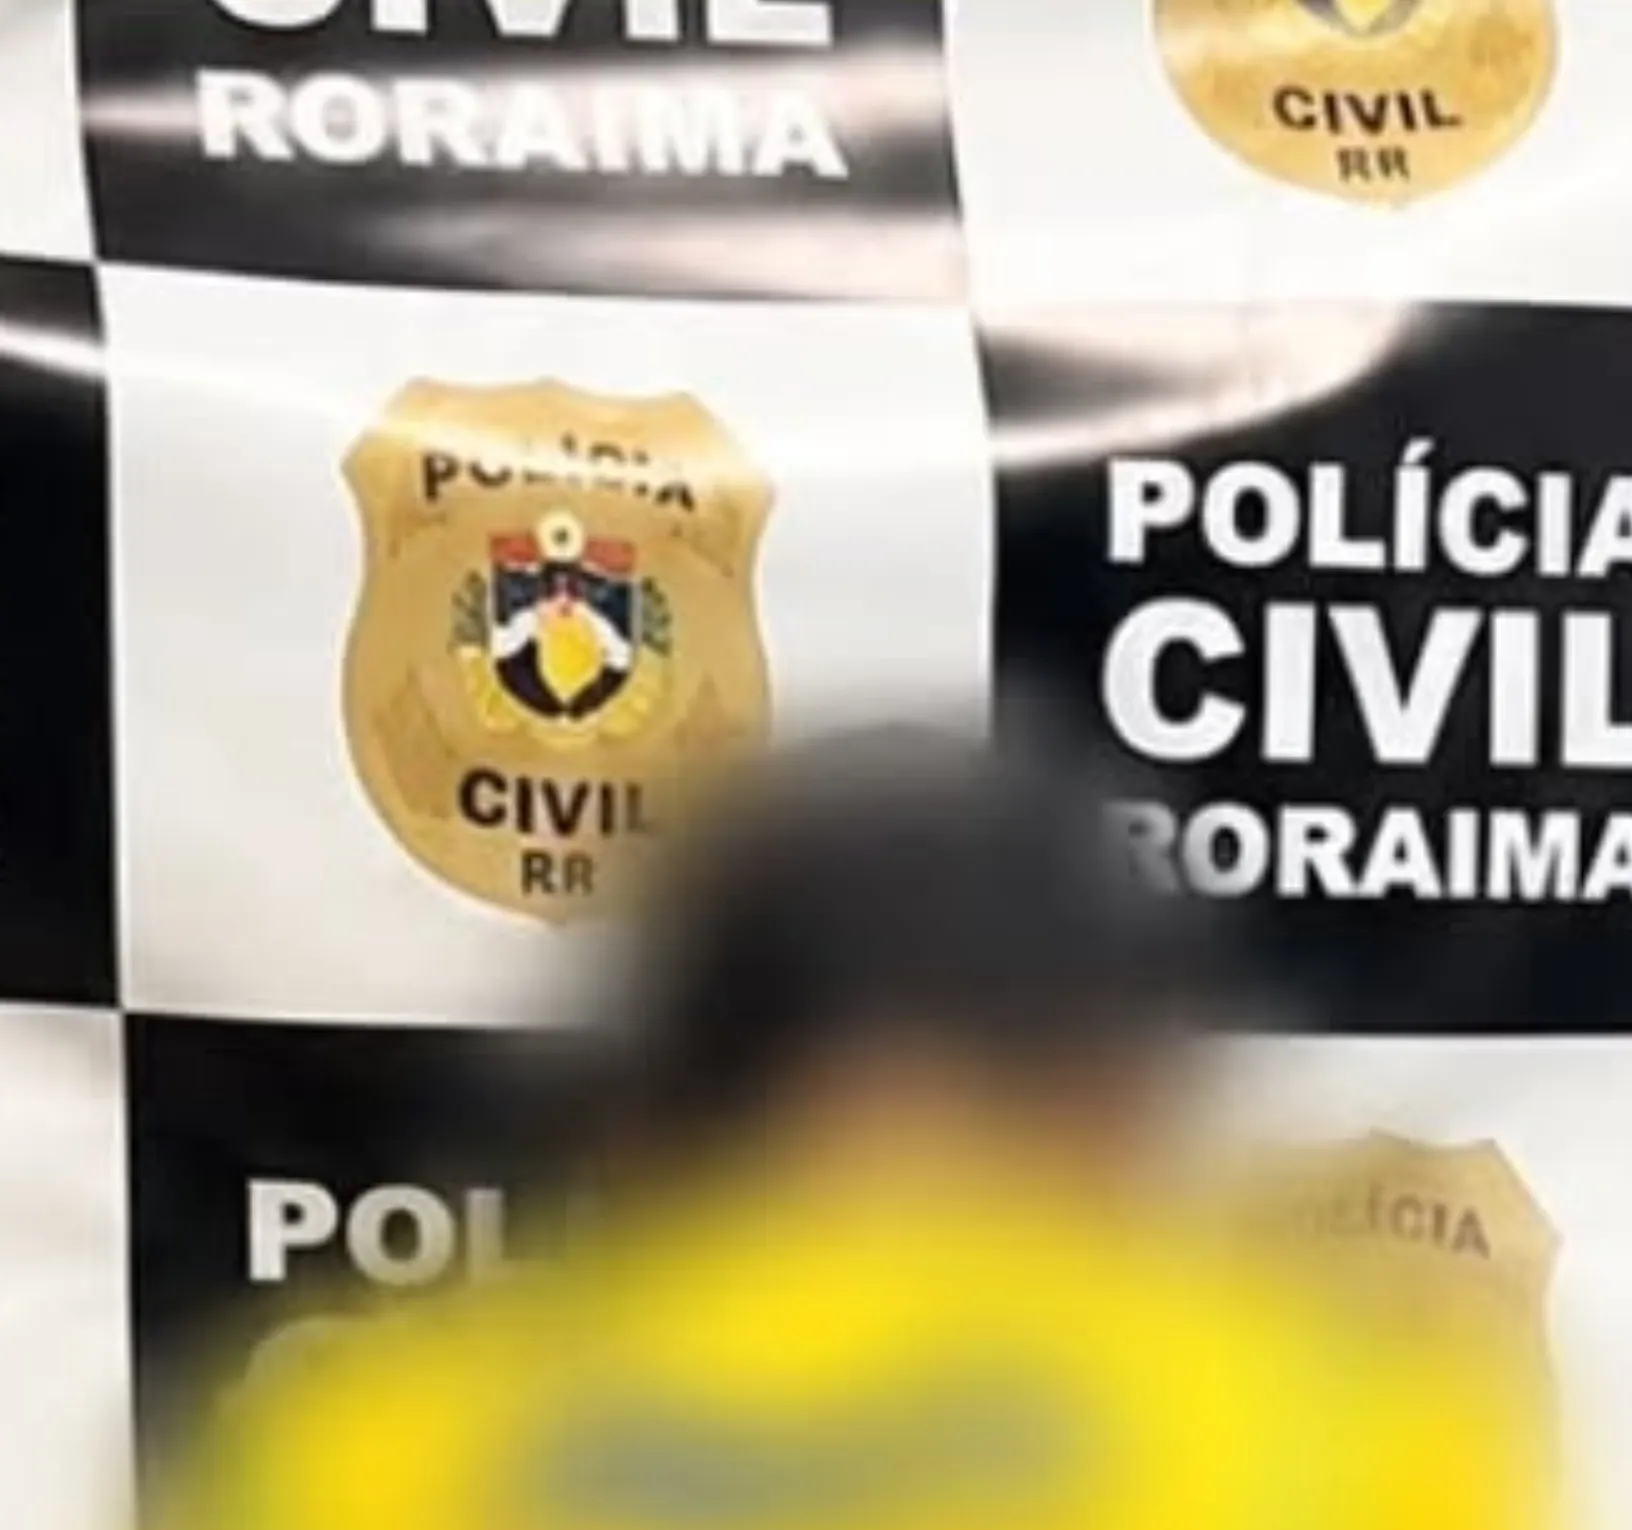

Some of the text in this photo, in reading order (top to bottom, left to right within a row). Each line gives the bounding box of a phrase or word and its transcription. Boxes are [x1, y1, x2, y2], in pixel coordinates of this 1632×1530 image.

[198, 68, 848, 178] RORAIMA
[1272, 85, 1463, 136] CIVIL
[1337, 145, 1410, 182] RR
[458, 767, 652, 837] CIVIL
[522, 850, 594, 896] RR
